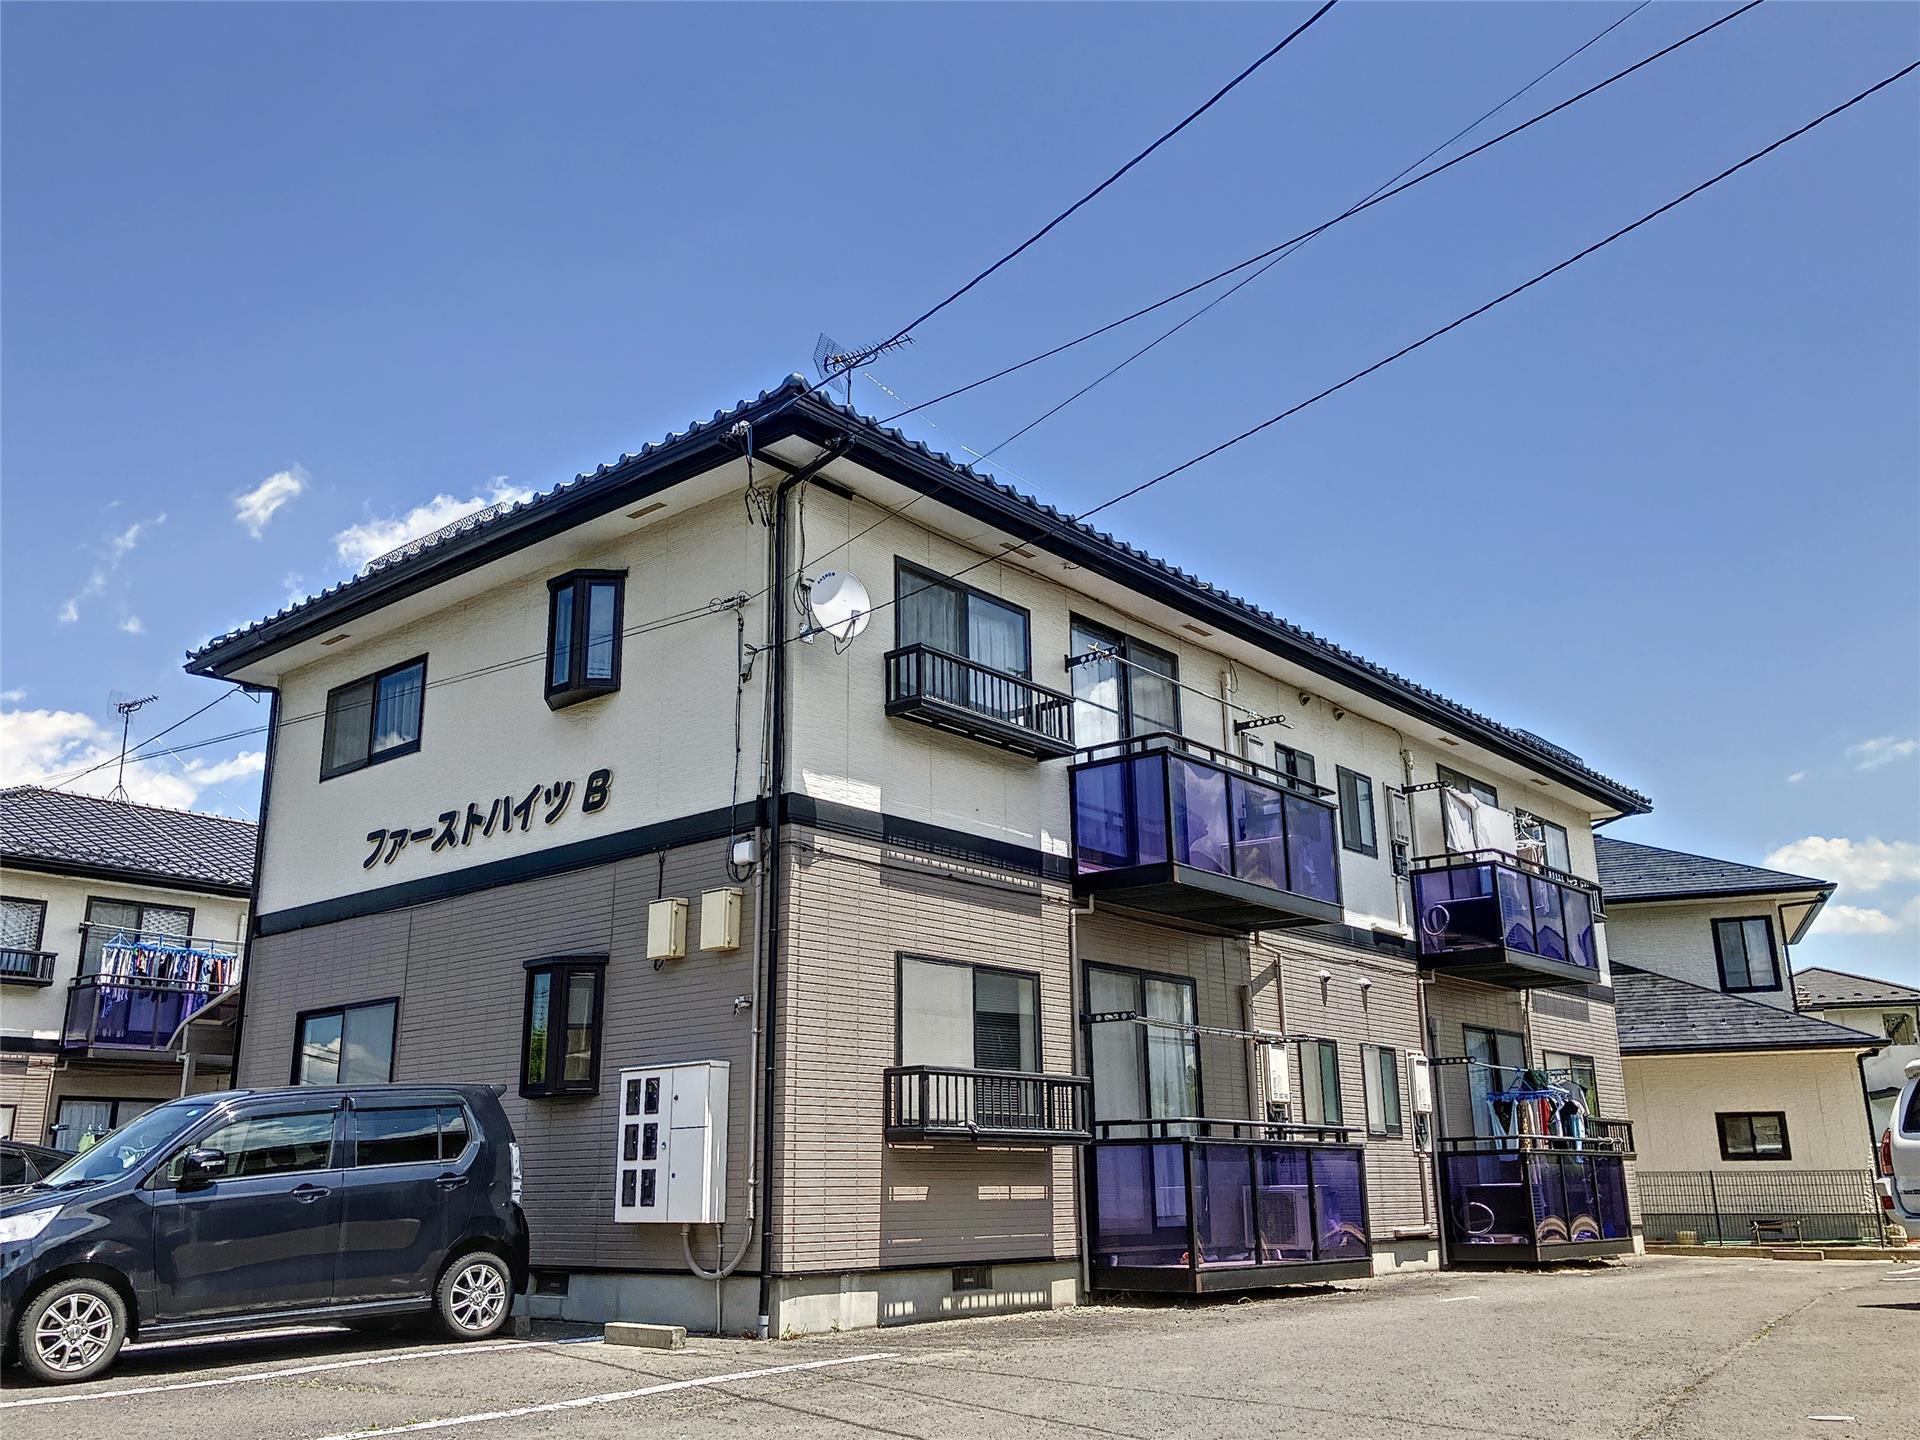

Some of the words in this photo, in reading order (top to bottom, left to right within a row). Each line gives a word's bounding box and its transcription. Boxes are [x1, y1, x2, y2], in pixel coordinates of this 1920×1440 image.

[363, 780, 575, 869] ファーストハイツ
[582, 768, 613, 814] B
